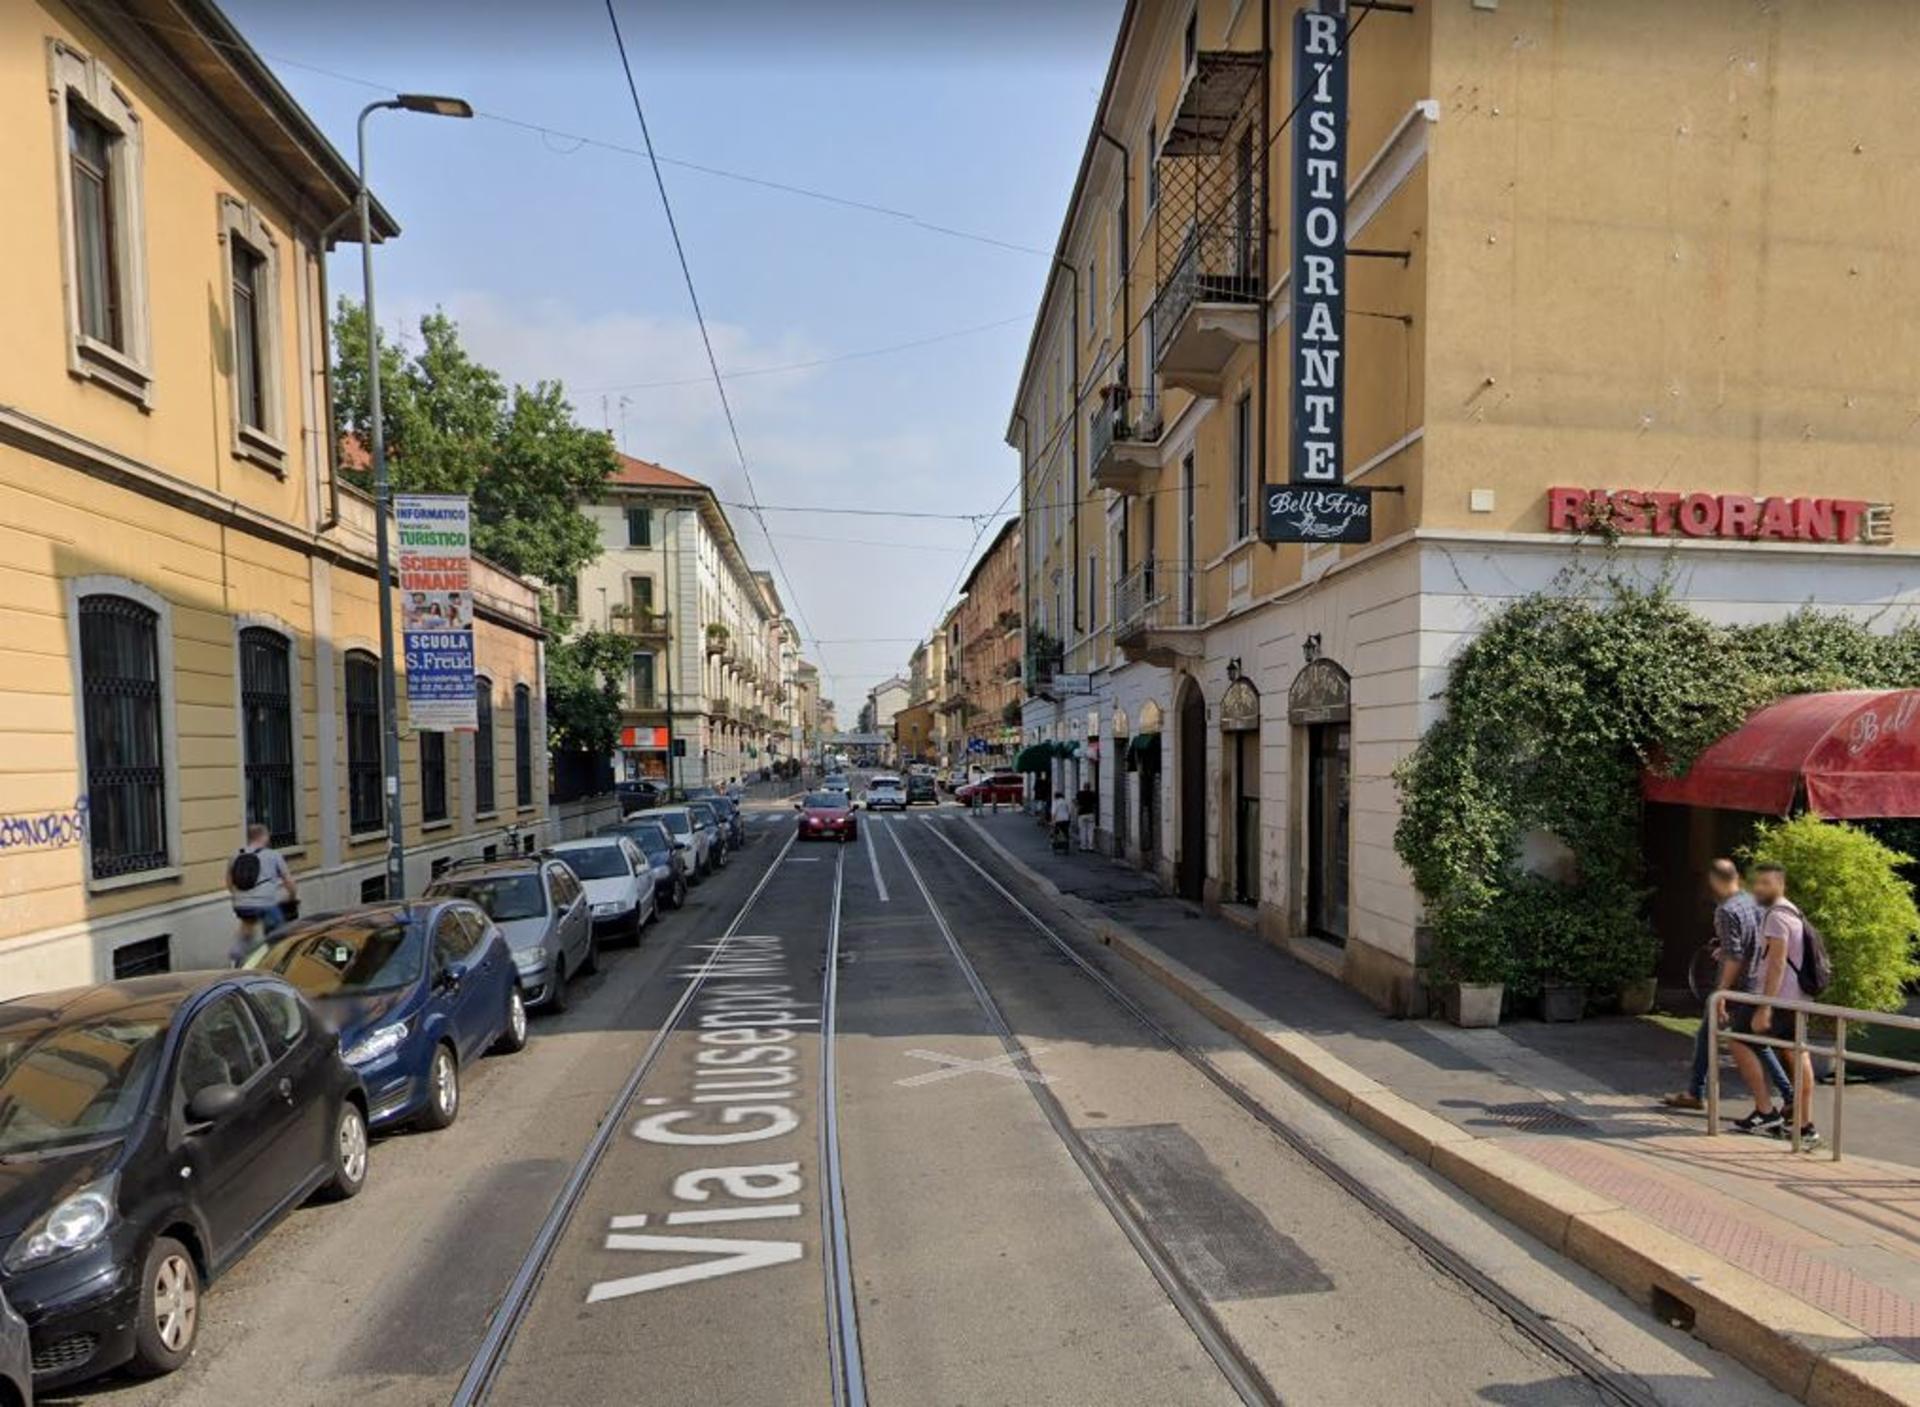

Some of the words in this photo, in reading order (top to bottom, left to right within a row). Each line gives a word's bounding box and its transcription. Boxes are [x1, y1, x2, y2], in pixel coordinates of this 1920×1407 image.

[1302, 14, 1340, 480] RISTORANTE
[396, 508, 466, 521] INFORMATICO
[398, 530, 467, 547] TURISTICO
[400, 555, 469, 572] SCIENZE
[401, 572, 469, 591] UMANE
[410, 634, 469, 650] SCUOLA
[631, 983, 822, 1146] Giuseppe
[586, 1161, 803, 1303] Via
